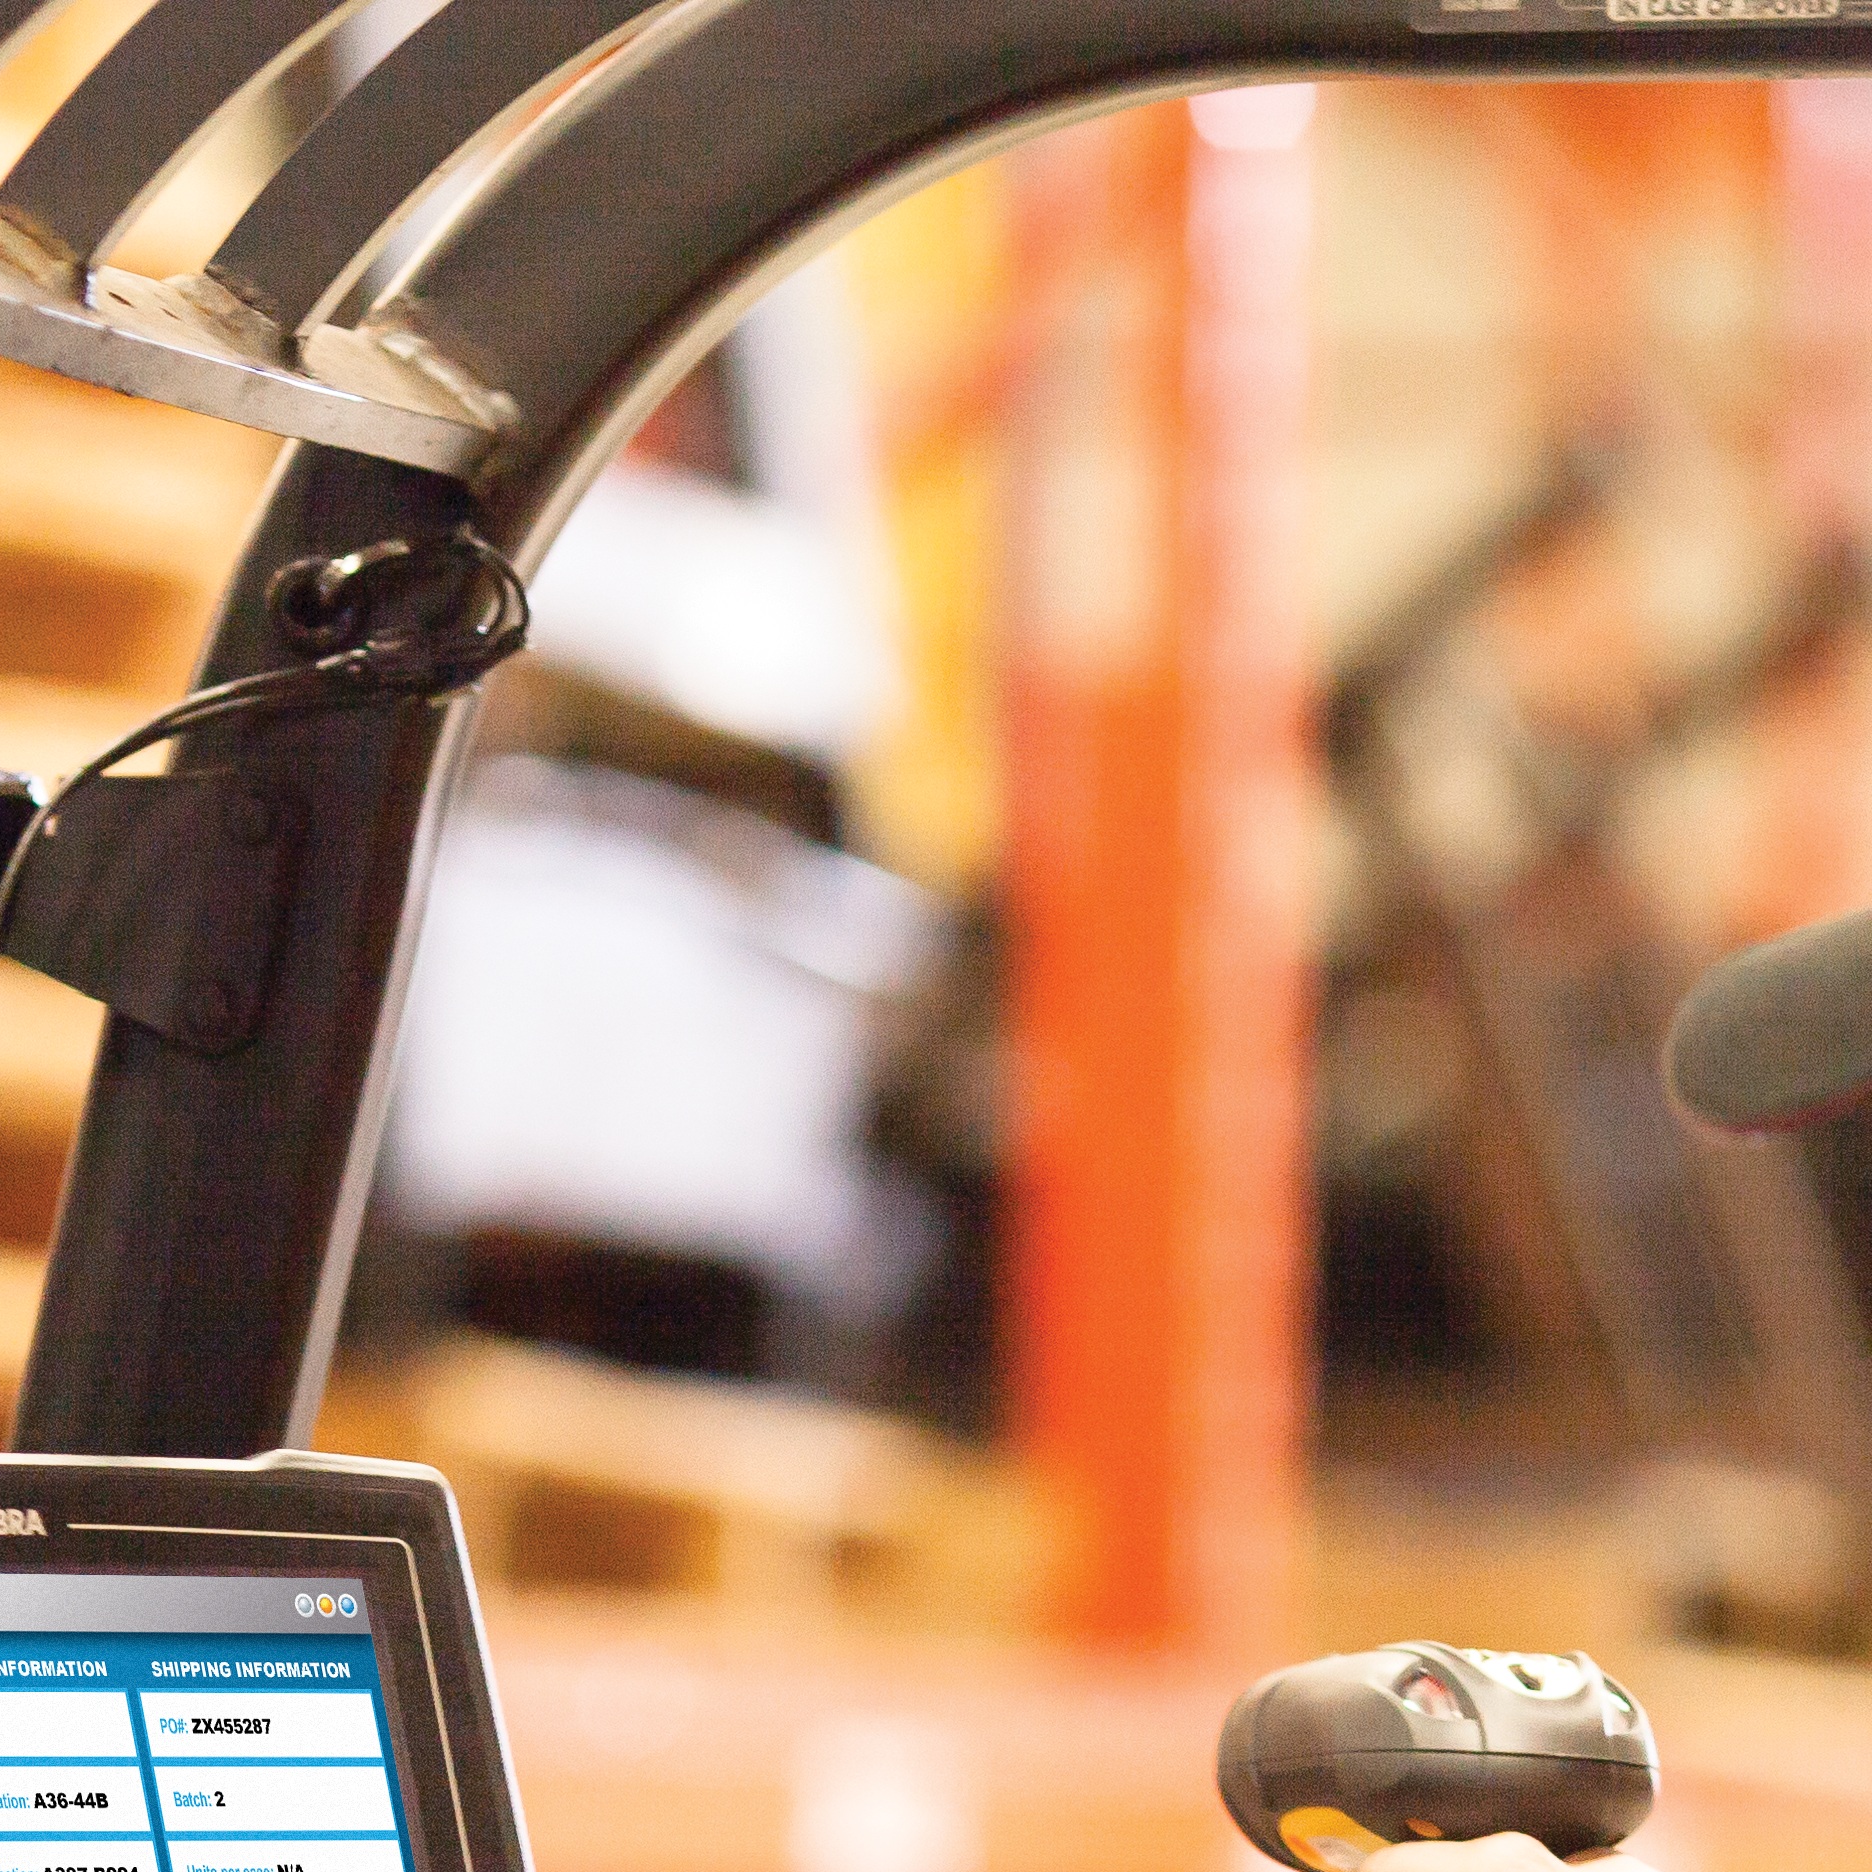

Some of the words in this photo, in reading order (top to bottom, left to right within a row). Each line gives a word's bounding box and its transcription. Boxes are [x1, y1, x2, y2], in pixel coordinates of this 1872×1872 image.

[151, 1661, 231, 1678] SHIPPING
[236, 1662, 351, 1678] INFORMATION
[159, 1718, 189, 1734] PO#:
[191, 1718, 271, 1735] ZX455287
[34, 1793, 109, 1809] A36-44B
[173, 1791, 212, 1807] Batch:
[214, 1791, 226, 1807] 2
